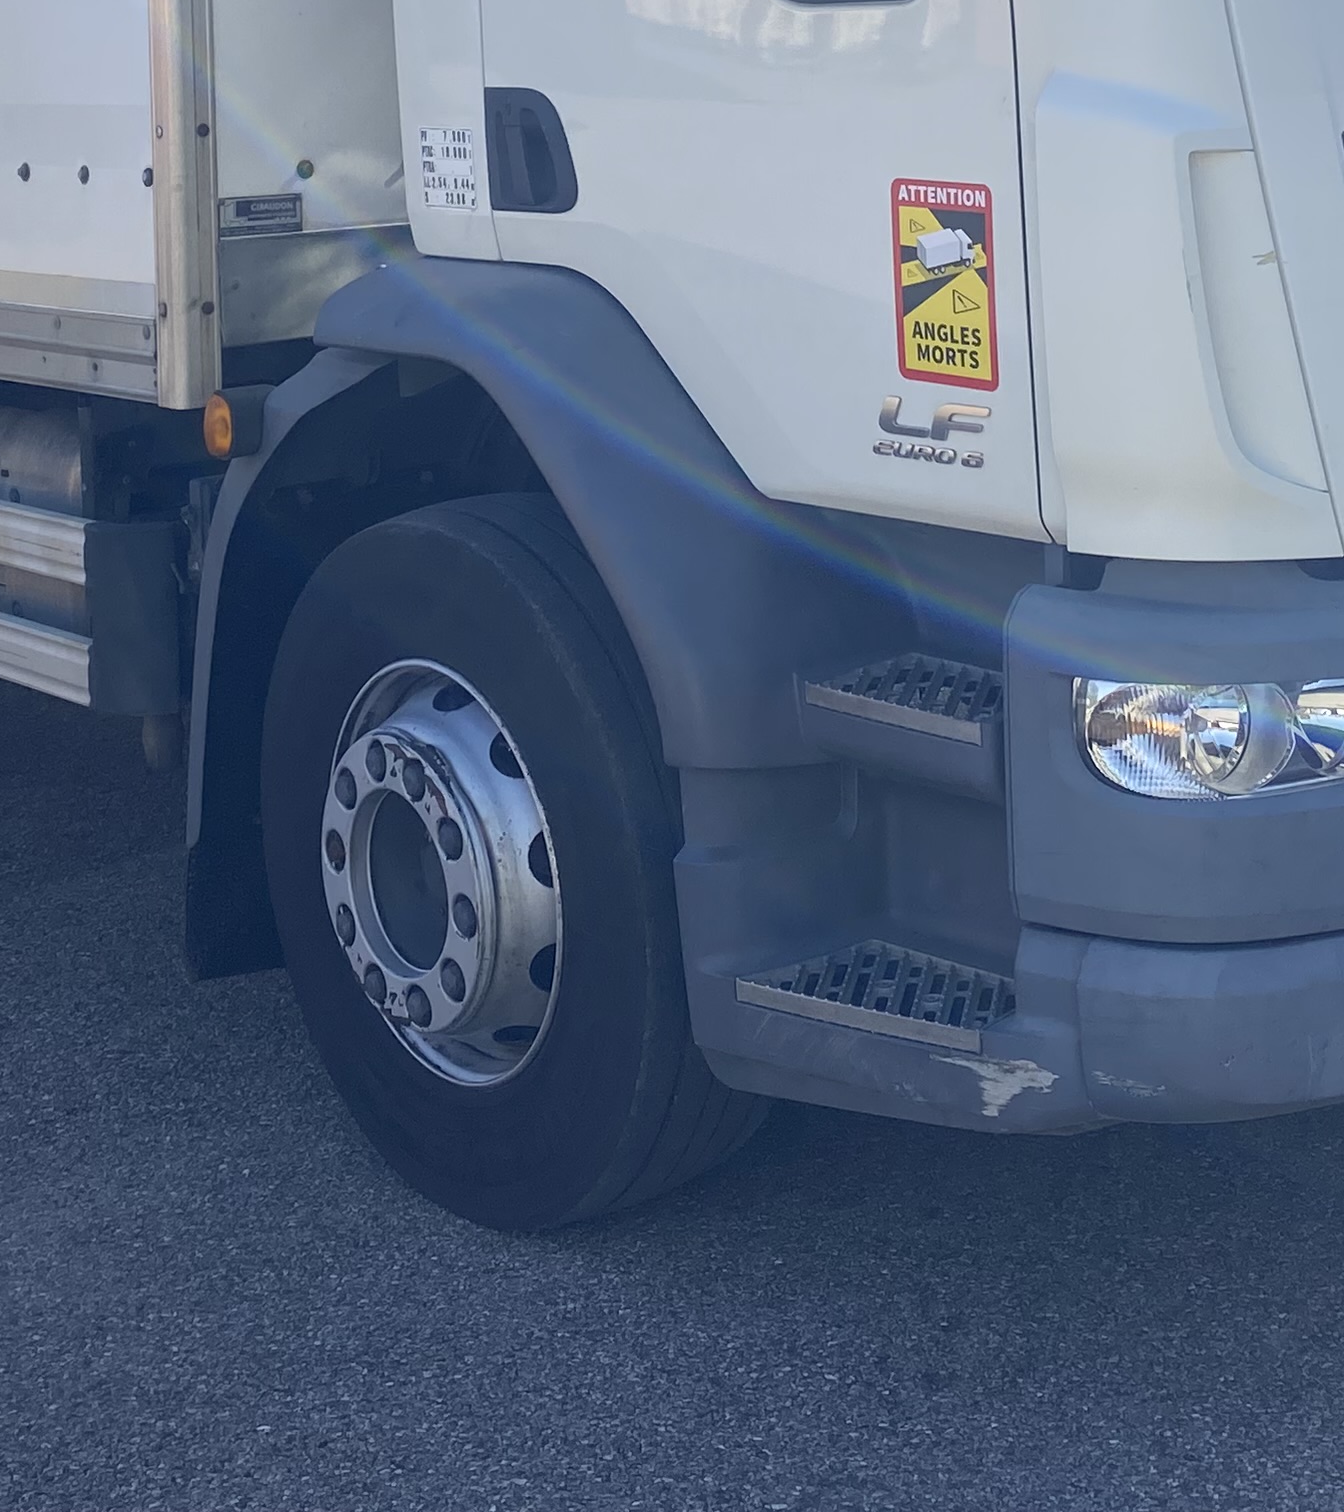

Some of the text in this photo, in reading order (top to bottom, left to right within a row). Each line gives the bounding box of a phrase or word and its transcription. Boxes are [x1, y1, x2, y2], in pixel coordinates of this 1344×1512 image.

[898, 184, 987, 208] ATTENTION
[912, 320, 982, 348] ANGLES
[917, 342, 980, 369] MORTS
[878, 394, 992, 441] LF
[872, 438, 985, 468] EURO 6
